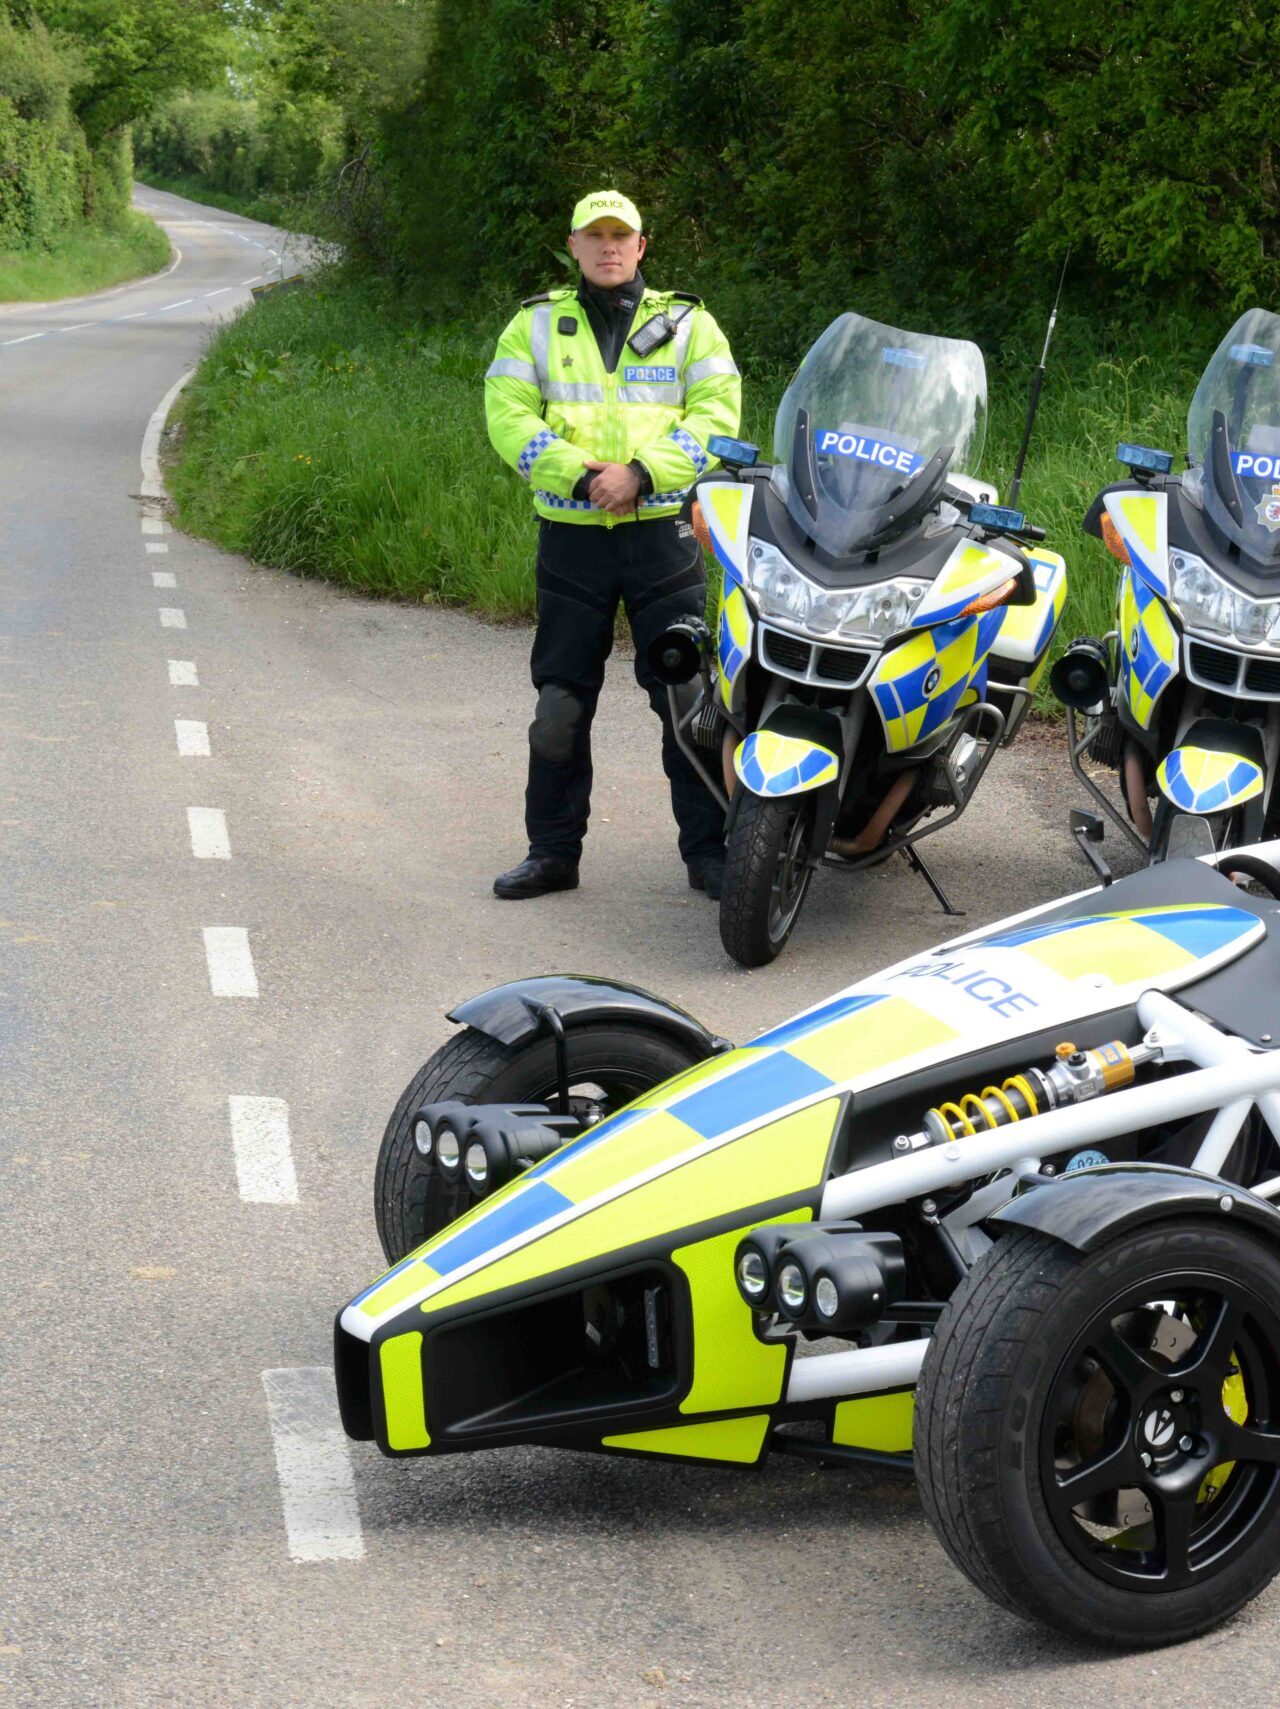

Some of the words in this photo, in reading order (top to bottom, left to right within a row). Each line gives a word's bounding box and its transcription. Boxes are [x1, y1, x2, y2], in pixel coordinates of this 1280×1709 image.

[590, 200, 625, 209] POLICE
[627, 368, 673, 380] POLICE
[821, 432, 914, 473] POLICE
[885, 962, 1039, 1018] POLICE
